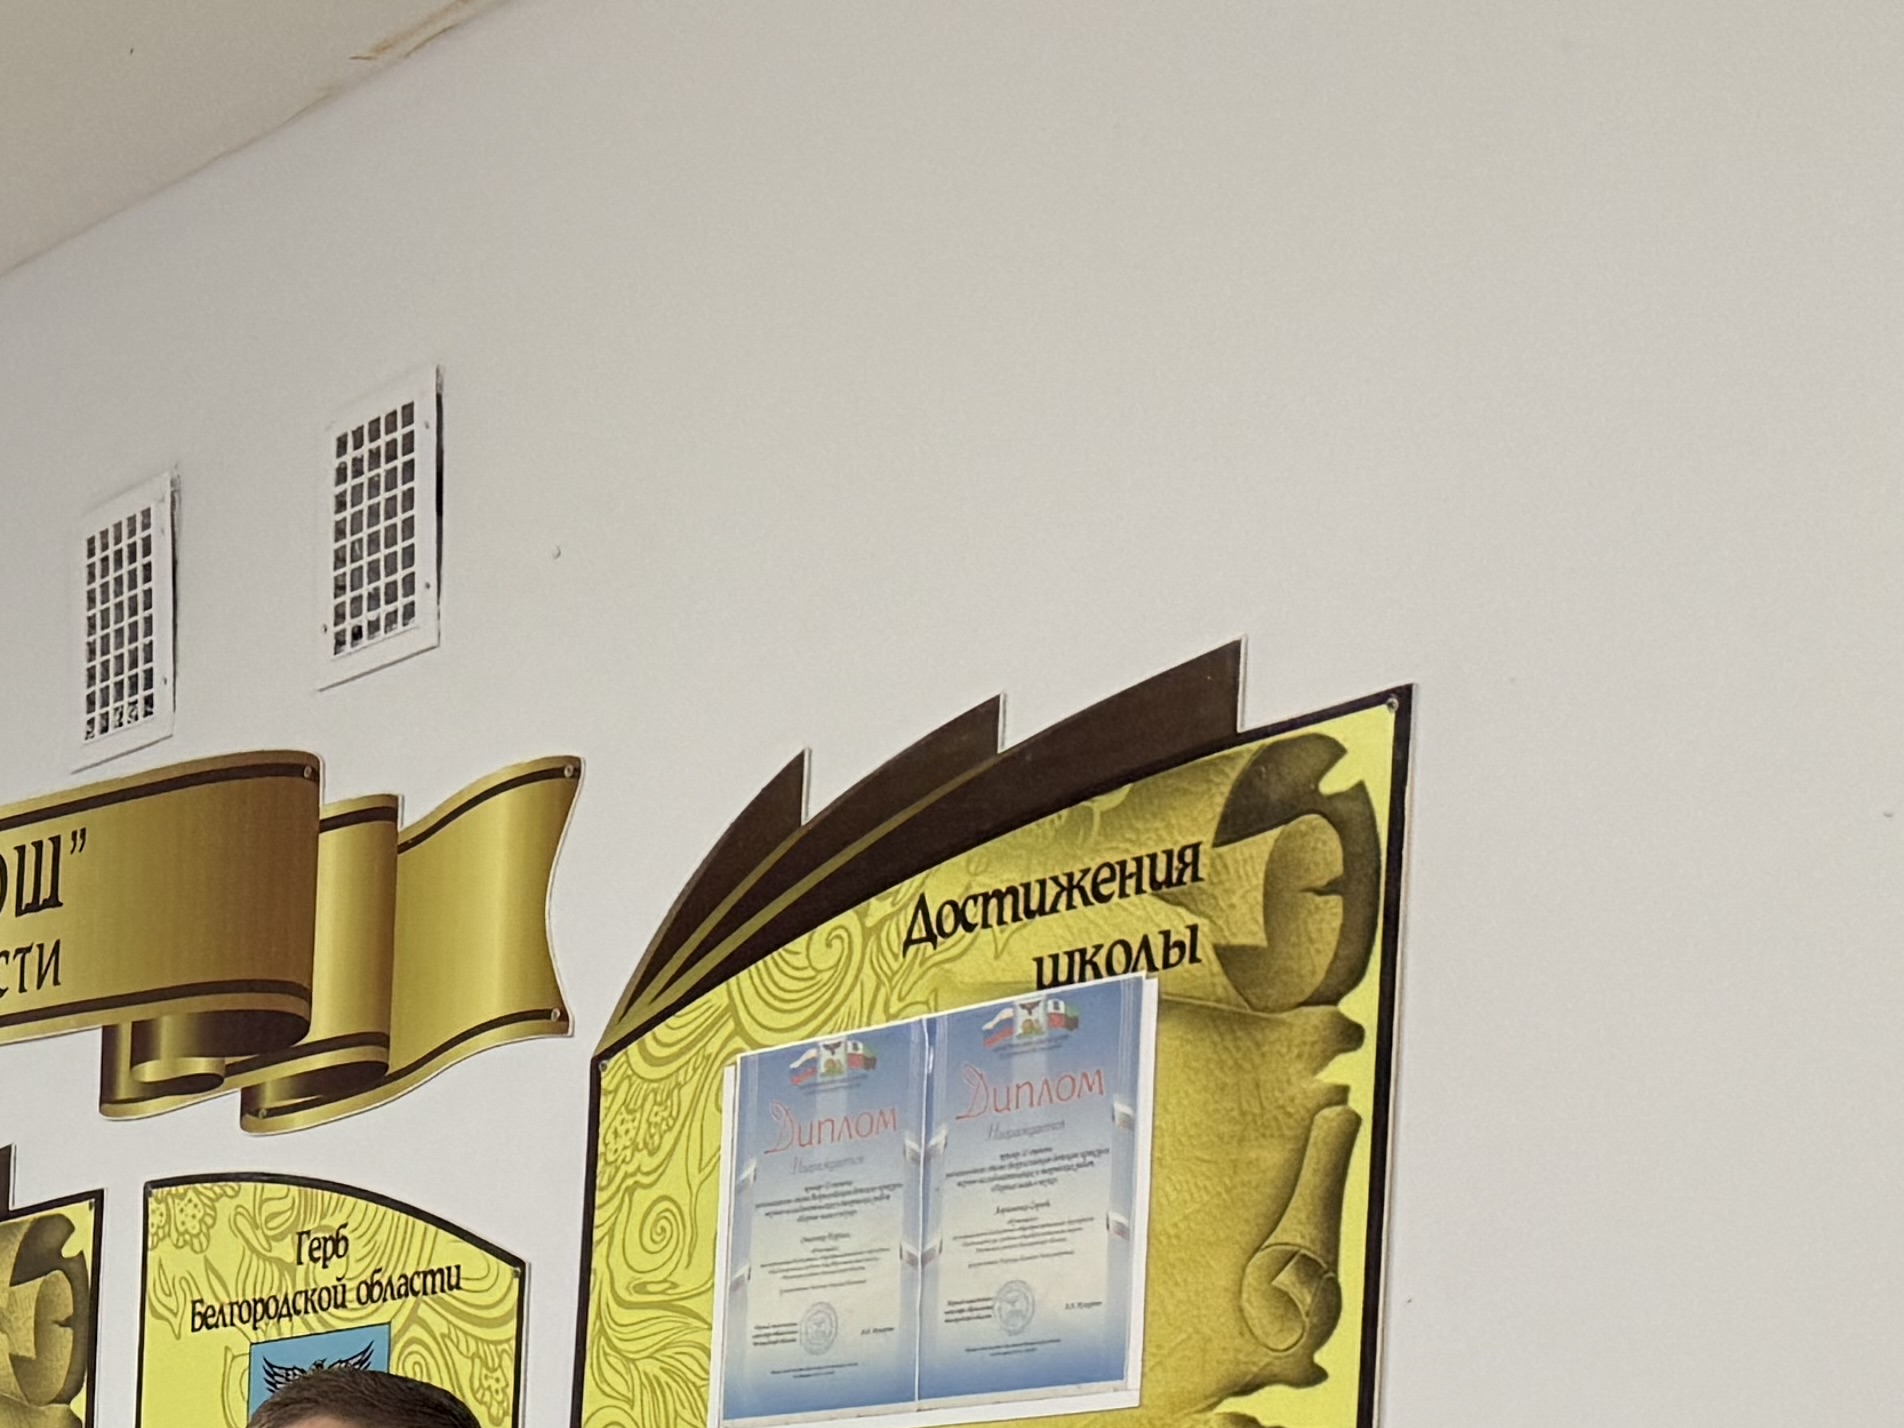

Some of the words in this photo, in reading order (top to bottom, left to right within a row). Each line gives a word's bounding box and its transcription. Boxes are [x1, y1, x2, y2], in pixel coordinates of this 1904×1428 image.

[903, 841, 1206, 957] Достижения
[1033, 924, 1202, 991] школы
[955, 1063, 1105, 1121] Диплом
[764, 1099, 898, 1155] Диплом
[295, 1223, 349, 1265] Герб
[190, 1277, 347, 1333] Белгородской
[356, 1264, 463, 1305] области
